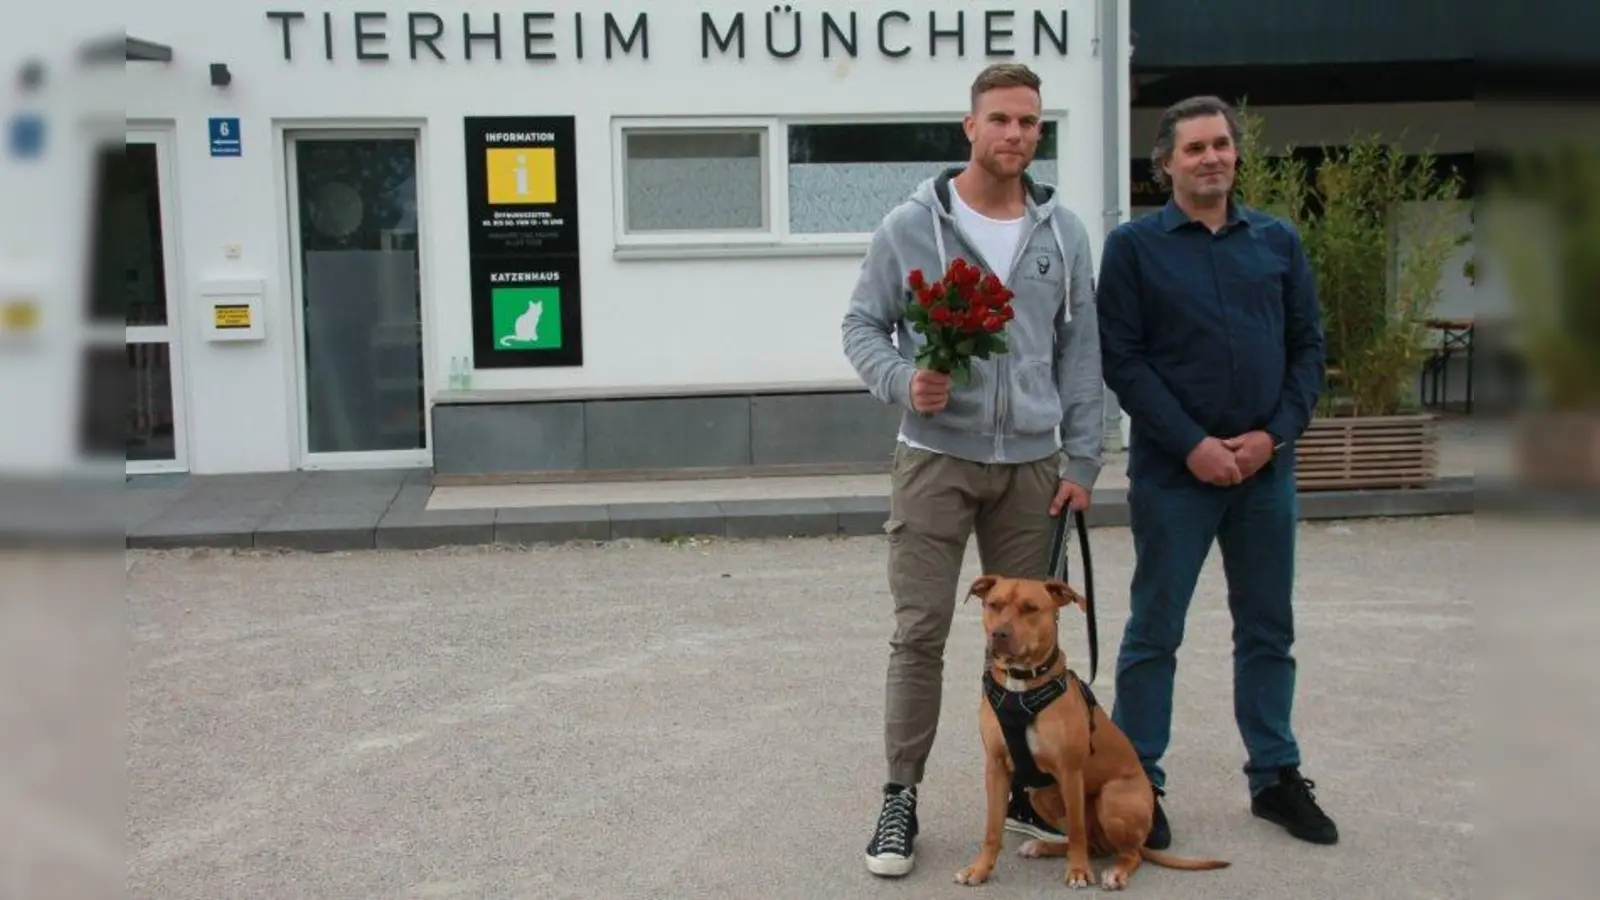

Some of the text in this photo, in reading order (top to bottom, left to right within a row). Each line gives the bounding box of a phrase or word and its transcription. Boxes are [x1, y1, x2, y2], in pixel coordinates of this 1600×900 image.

[266, 5, 1068, 61] TIERHEIM MÜNCHEN
[220, 121, 230, 137] 6
[485, 132, 555, 142] INFORMATION
[490, 271, 560, 282] KATZENHAUS
